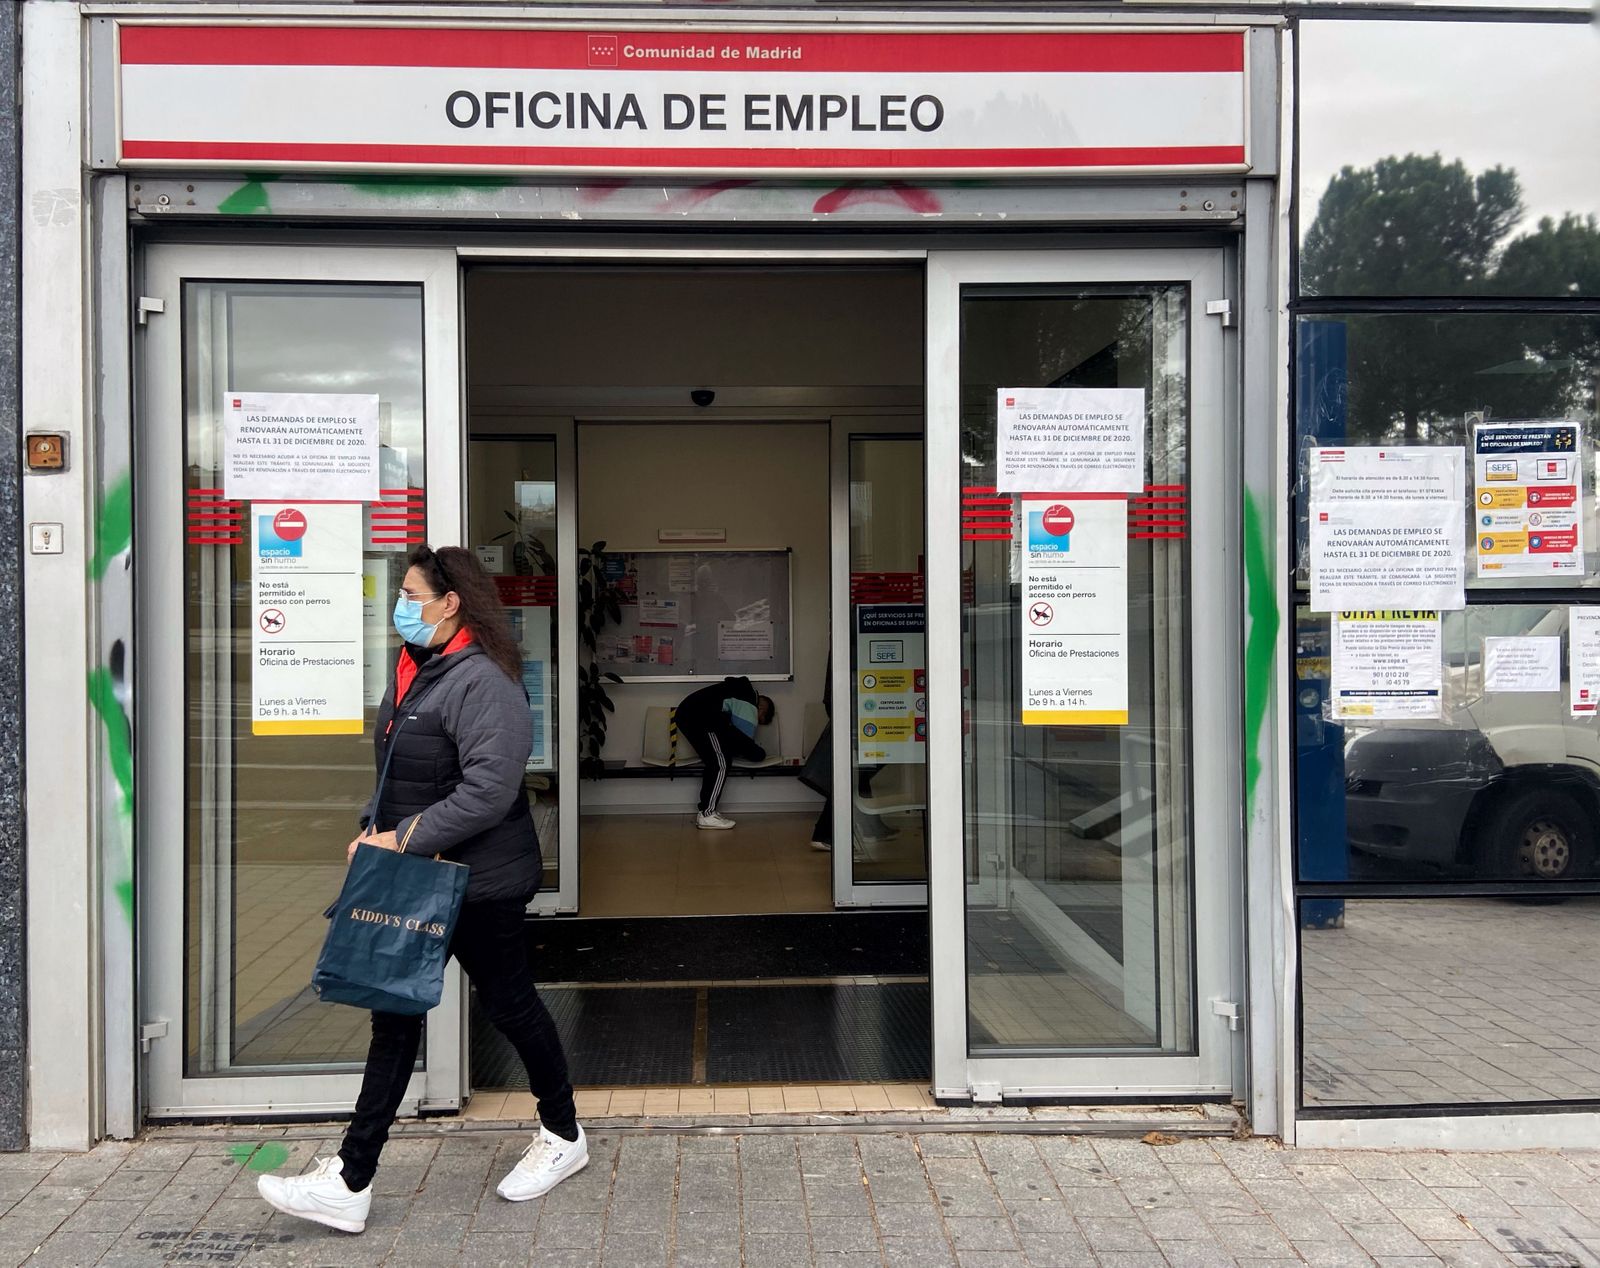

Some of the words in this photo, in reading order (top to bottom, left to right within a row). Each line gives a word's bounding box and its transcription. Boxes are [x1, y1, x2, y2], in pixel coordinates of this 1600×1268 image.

[623, 45, 715, 58] Comunidad
[721, 46, 740, 59] de
[746, 46, 802, 59] Madrid
[445, 90, 648, 130] OFICINA
[663, 94, 727, 131] DE
[744, 94, 945, 133] EMPLEO
[240, 426, 287, 434] RENOVARÁN
[289, 427, 363, 435] AUTOMÁTICAMENTE
[1013, 423, 1056, 431] RENOVARÁN
[1058, 423, 1129, 431] AUTOMÁTICAMENTE
[1327, 539, 1373, 547] RENOVARÁN
[1375, 538, 1449, 546] AUTOMÁTICAMENTE
[260, 548, 290, 557] espacio
[1030, 544, 1058, 552] espacio
[306, 598, 331, 606] perros
[259, 658, 288, 666] Oficina
[1029, 688, 1053, 696] Lunes
[1063, 688, 1092, 696] Viernes
[259, 698, 285, 706] Lunes
[295, 697, 326, 705] Viernes
[1029, 698, 1040, 706] De
[1043, 698, 1048, 706] 9
[1050, 698, 1057, 706] h.
[259, 708, 271, 716] De
[274, 708, 279, 716] 9
[282, 708, 289, 716] h.
[406, 918, 446, 936] CLASS
[552, 1153, 563, 1165] FILA
